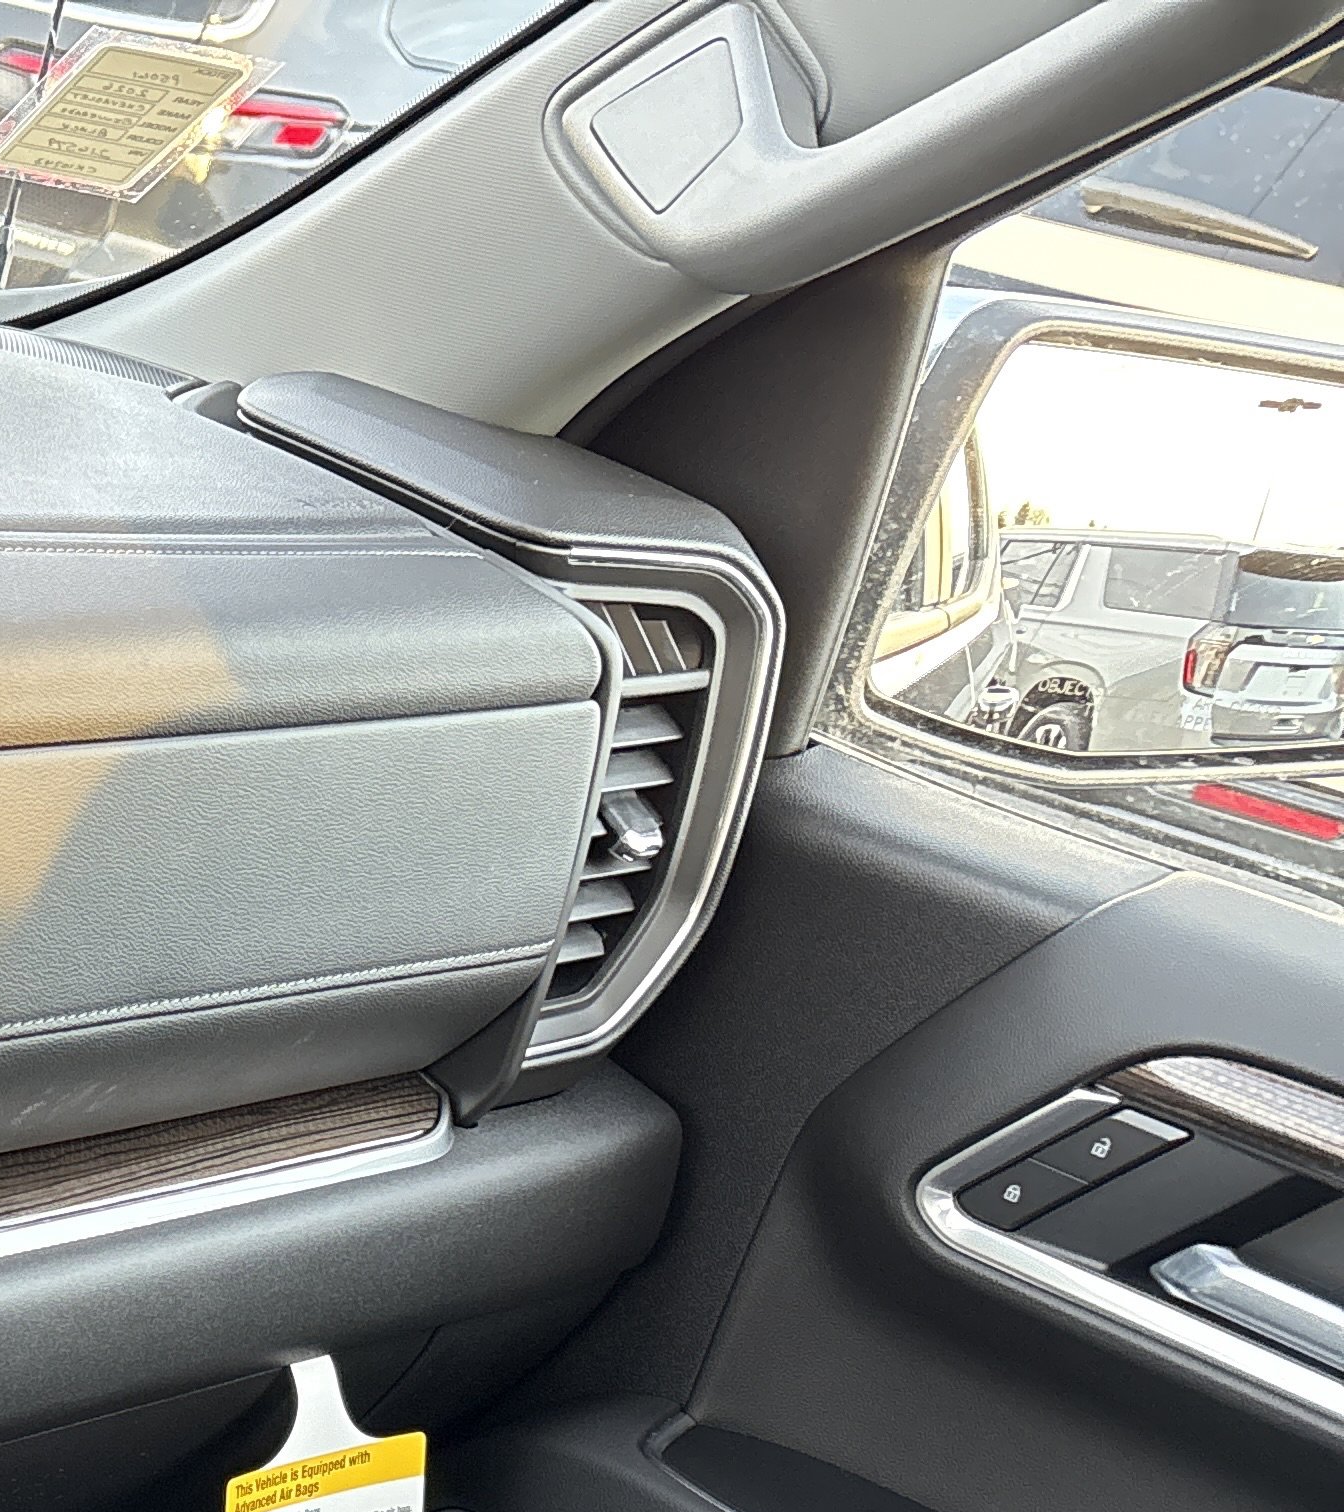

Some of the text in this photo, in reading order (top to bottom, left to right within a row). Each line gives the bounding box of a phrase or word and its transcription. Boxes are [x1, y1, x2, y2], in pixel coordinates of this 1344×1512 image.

[235, 1450, 371, 1499] This Vehicle is Equipped with
[279, 1486, 293, 1503] Air
[295, 1481, 320, 1498] Bags
